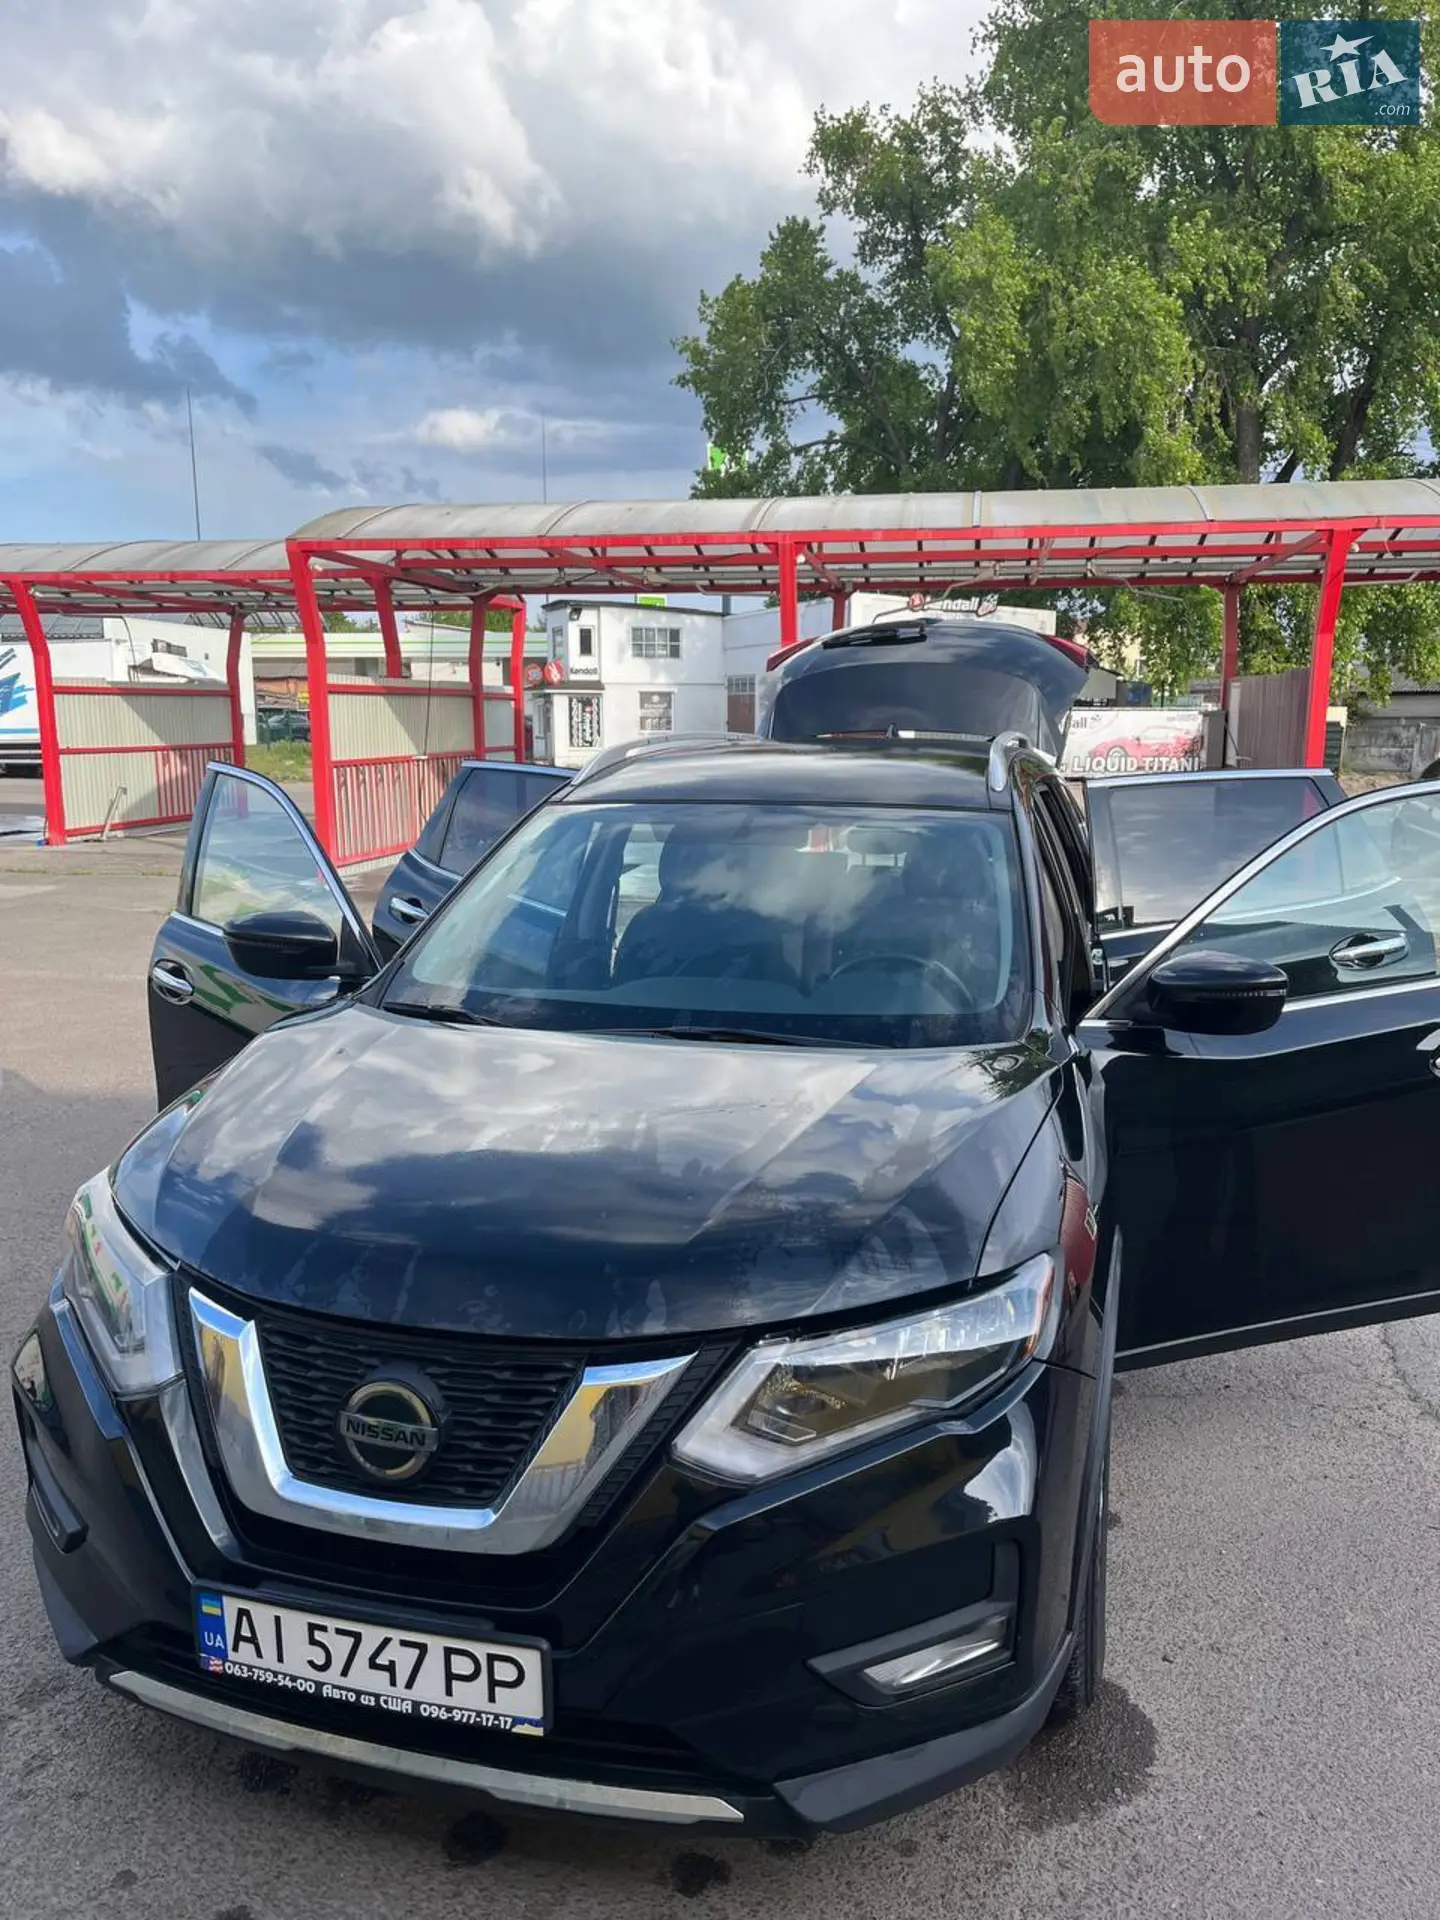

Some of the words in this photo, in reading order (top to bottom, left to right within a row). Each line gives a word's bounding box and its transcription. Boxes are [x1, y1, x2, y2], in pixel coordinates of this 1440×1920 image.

[1072, 755, 1139, 773] LIQUID
[346, 1419, 426, 1447] NISSAN
[204, 1630, 226, 1650] UA
[231, 1606, 285, 1664] AI
[306, 1620, 430, 1691] 5747
[442, 1644, 527, 1705] PP
[224, 1661, 316, 1694] 063-759-54-00
[321, 1684, 356, 1702] Авто
[360, 1694, 376, 1707] из
[379, 1695, 413, 1714] США
[419, 1703, 513, 1730] 096-977-17-17
